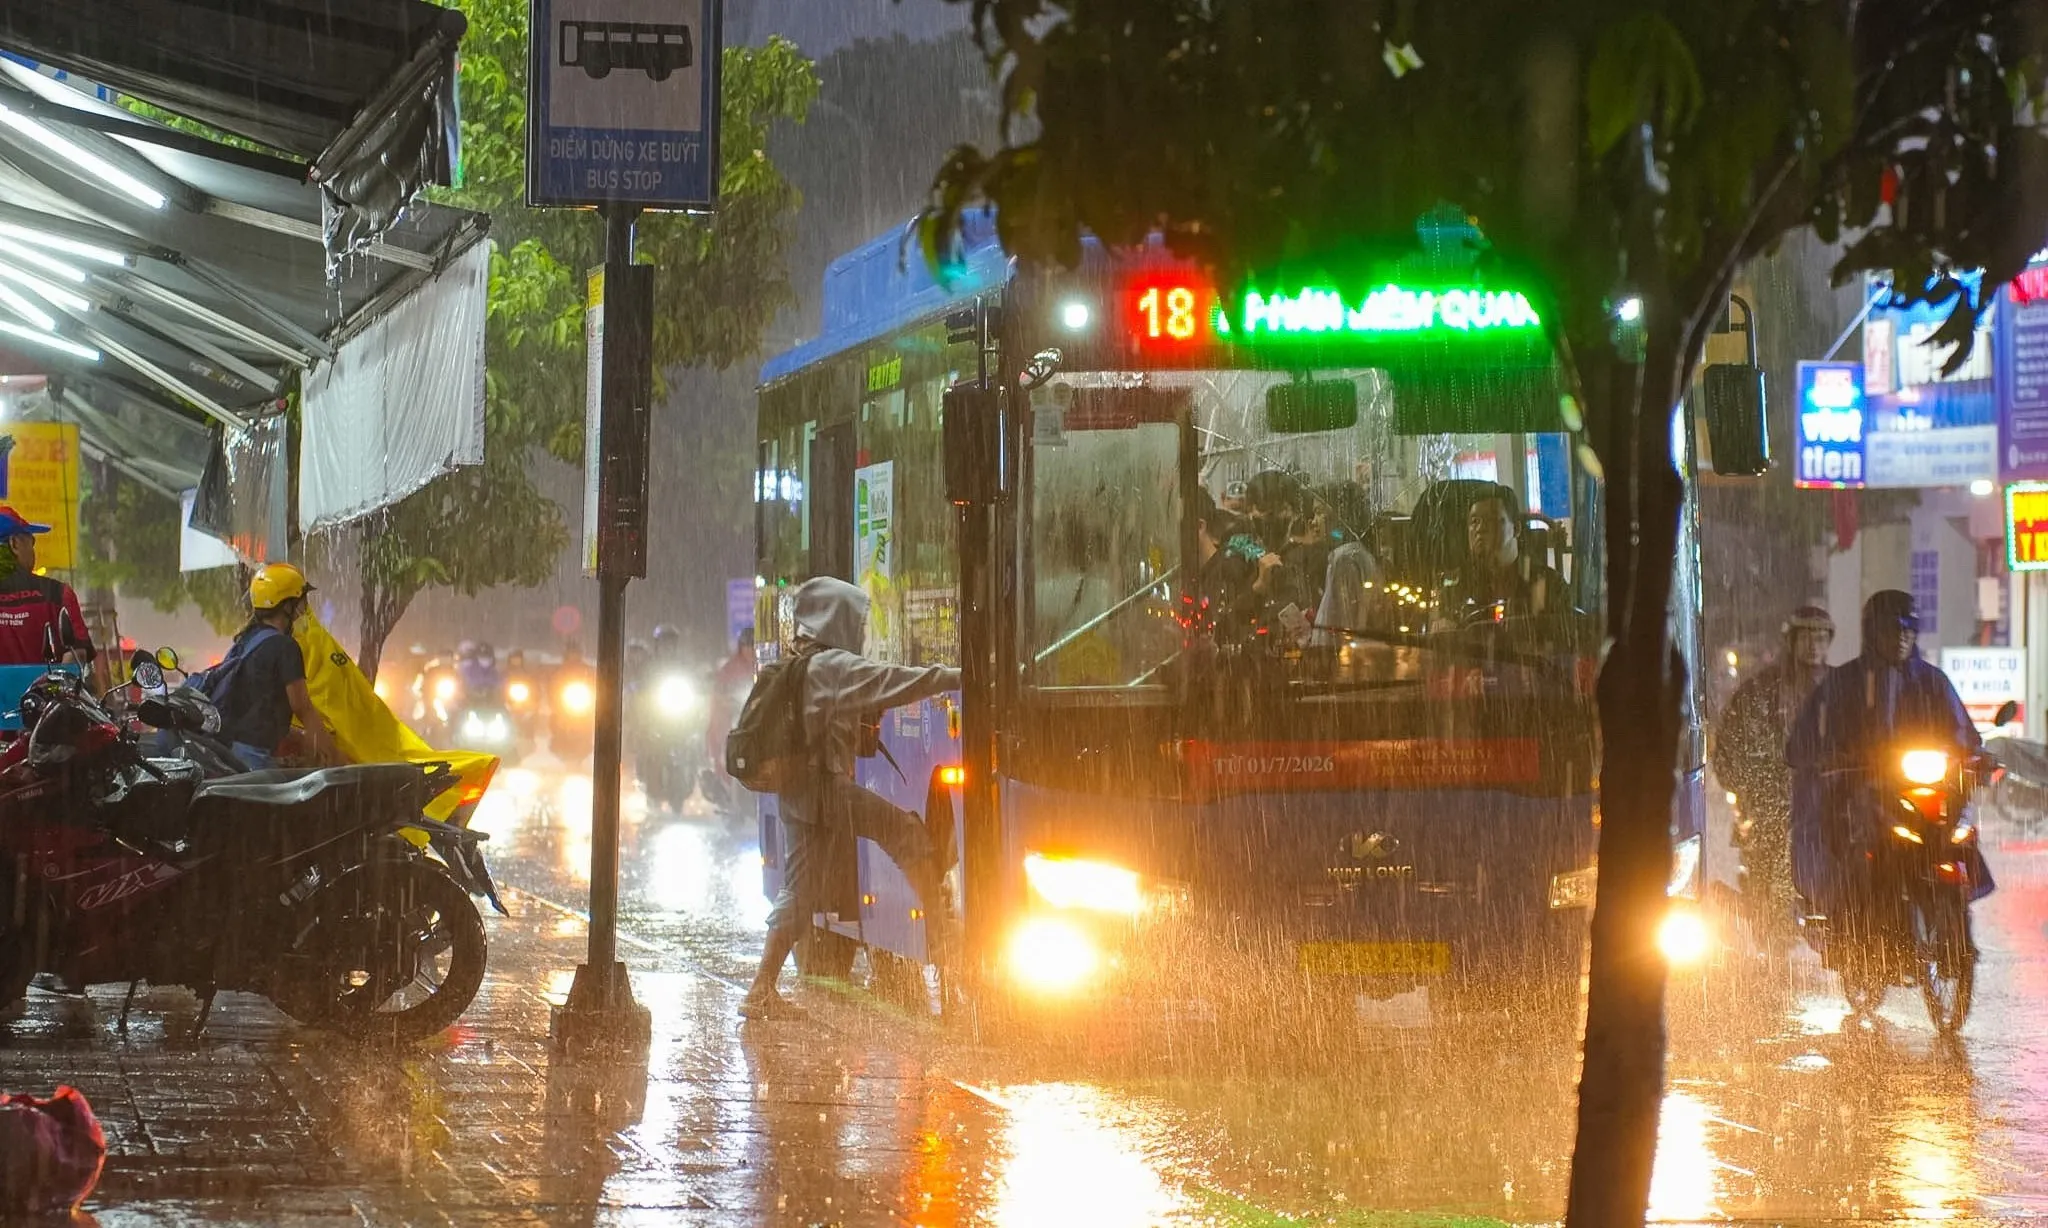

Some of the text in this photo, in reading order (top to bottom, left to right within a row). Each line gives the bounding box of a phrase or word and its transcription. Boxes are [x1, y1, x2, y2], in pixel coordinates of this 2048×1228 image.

[550, 129, 700, 163] ĐIỂM DỪNG XE BUÝT
[587, 169, 662, 191] BUS STOP
[1139, 287, 1195, 339] 18
[1248, 755, 1334, 773] 01/7/2026
